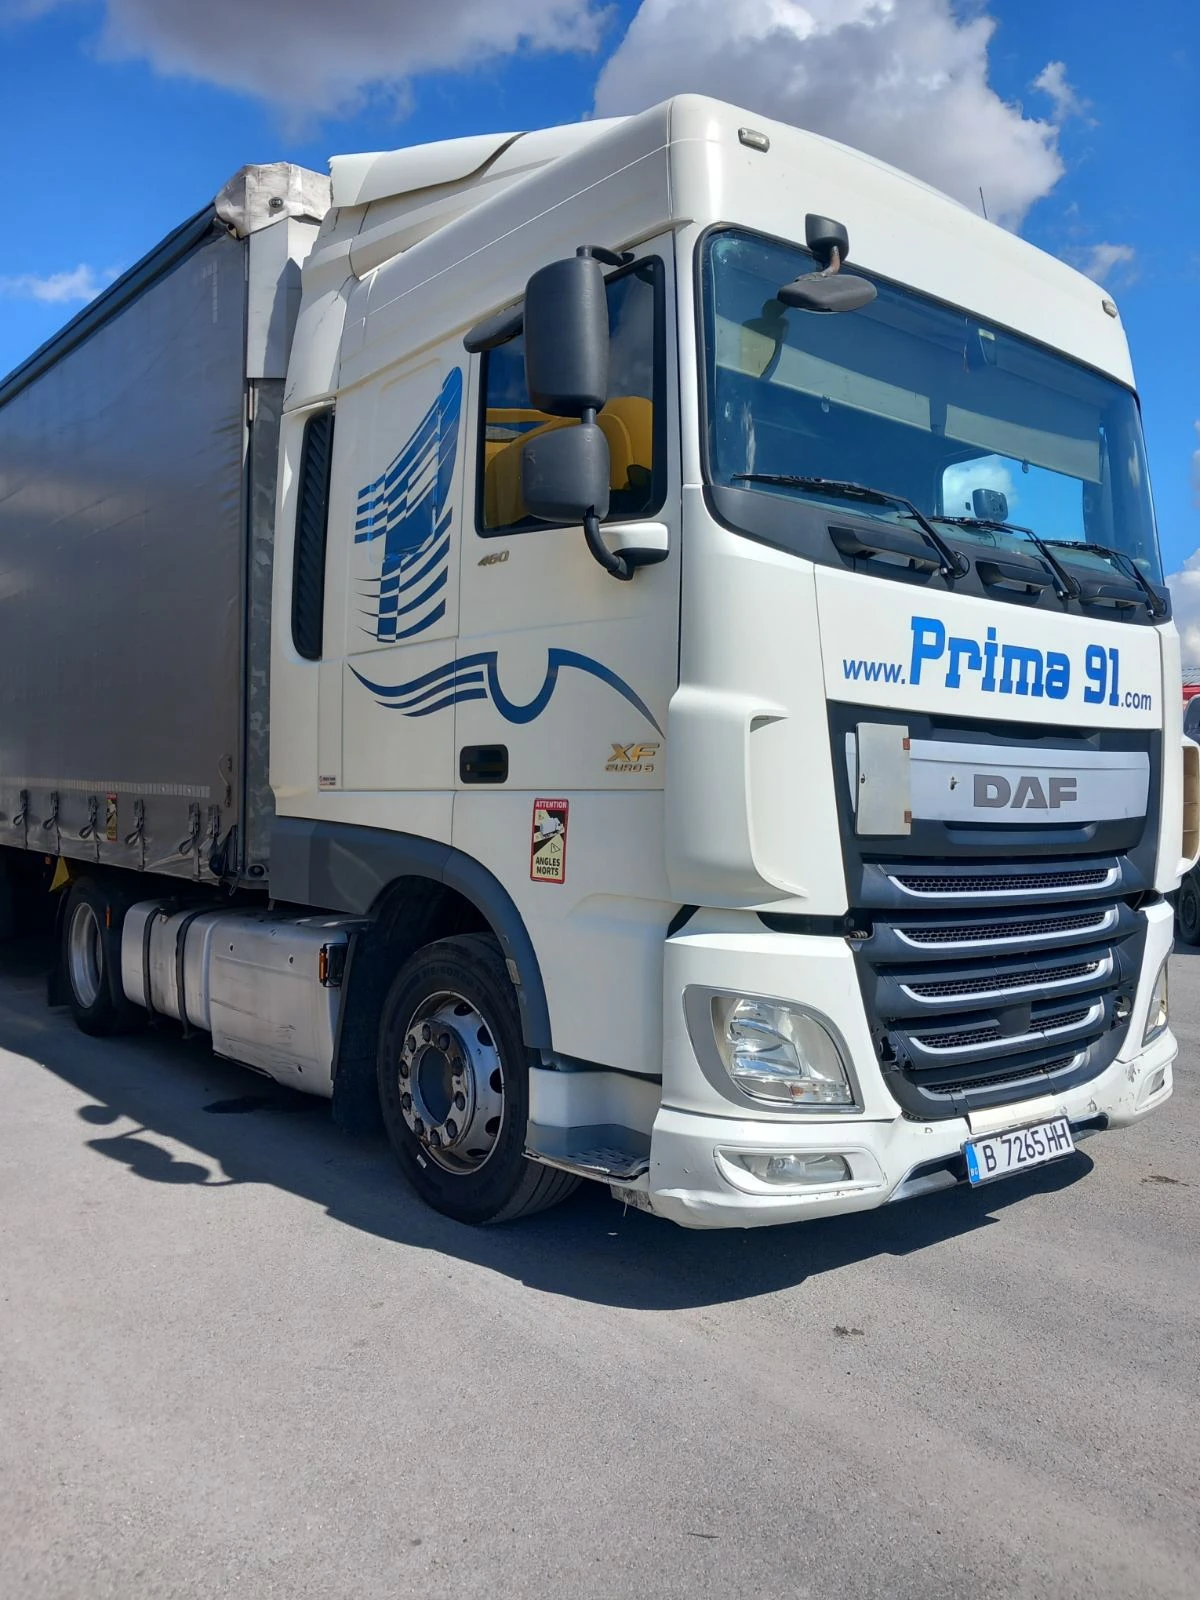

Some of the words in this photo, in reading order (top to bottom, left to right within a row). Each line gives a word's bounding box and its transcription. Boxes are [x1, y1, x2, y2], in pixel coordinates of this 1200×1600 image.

[477, 550, 510, 567] 460
[607, 742, 660, 762] XF
[973, 774, 1078, 810] DAF
[535, 800, 567, 809] ATTENTION
[535, 856, 561, 868] ANGLES
[982, 1144, 998, 1173] B
